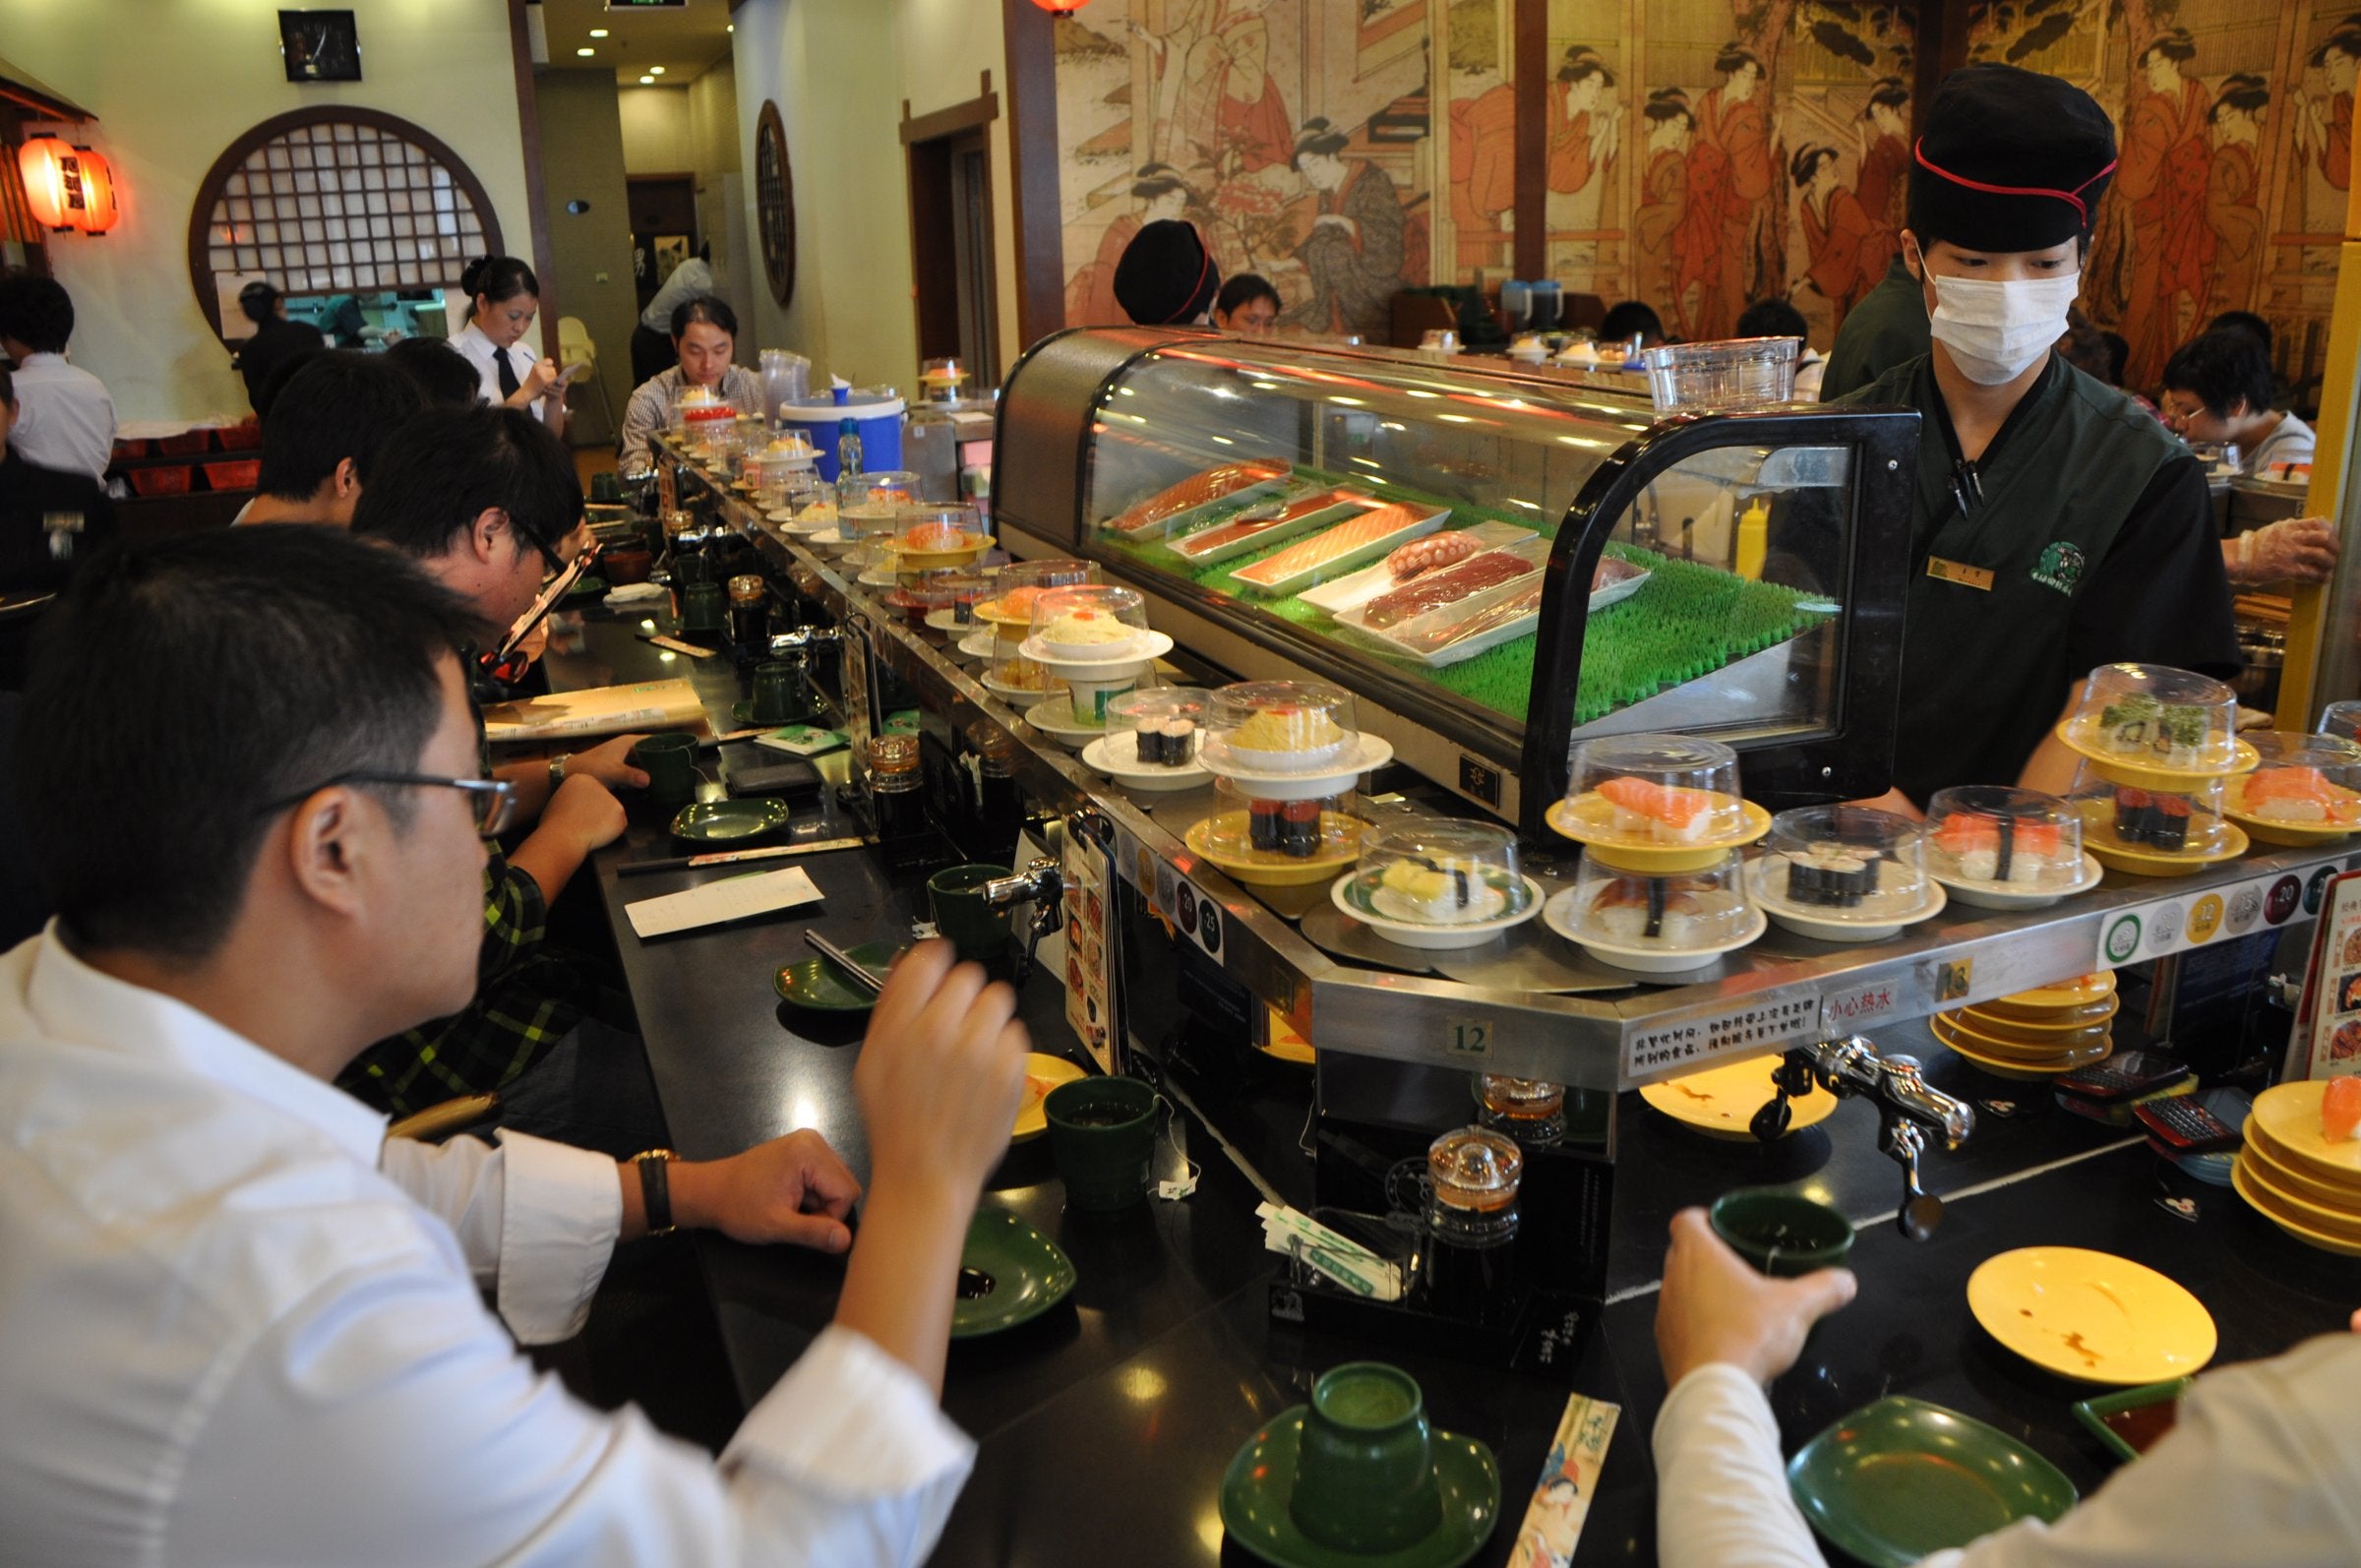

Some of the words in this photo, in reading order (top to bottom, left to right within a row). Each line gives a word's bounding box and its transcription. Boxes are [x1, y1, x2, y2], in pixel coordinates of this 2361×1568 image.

[1830, 988, 1891, 1022] 小心热水
[1453, 1025, 1486, 1053] 12
